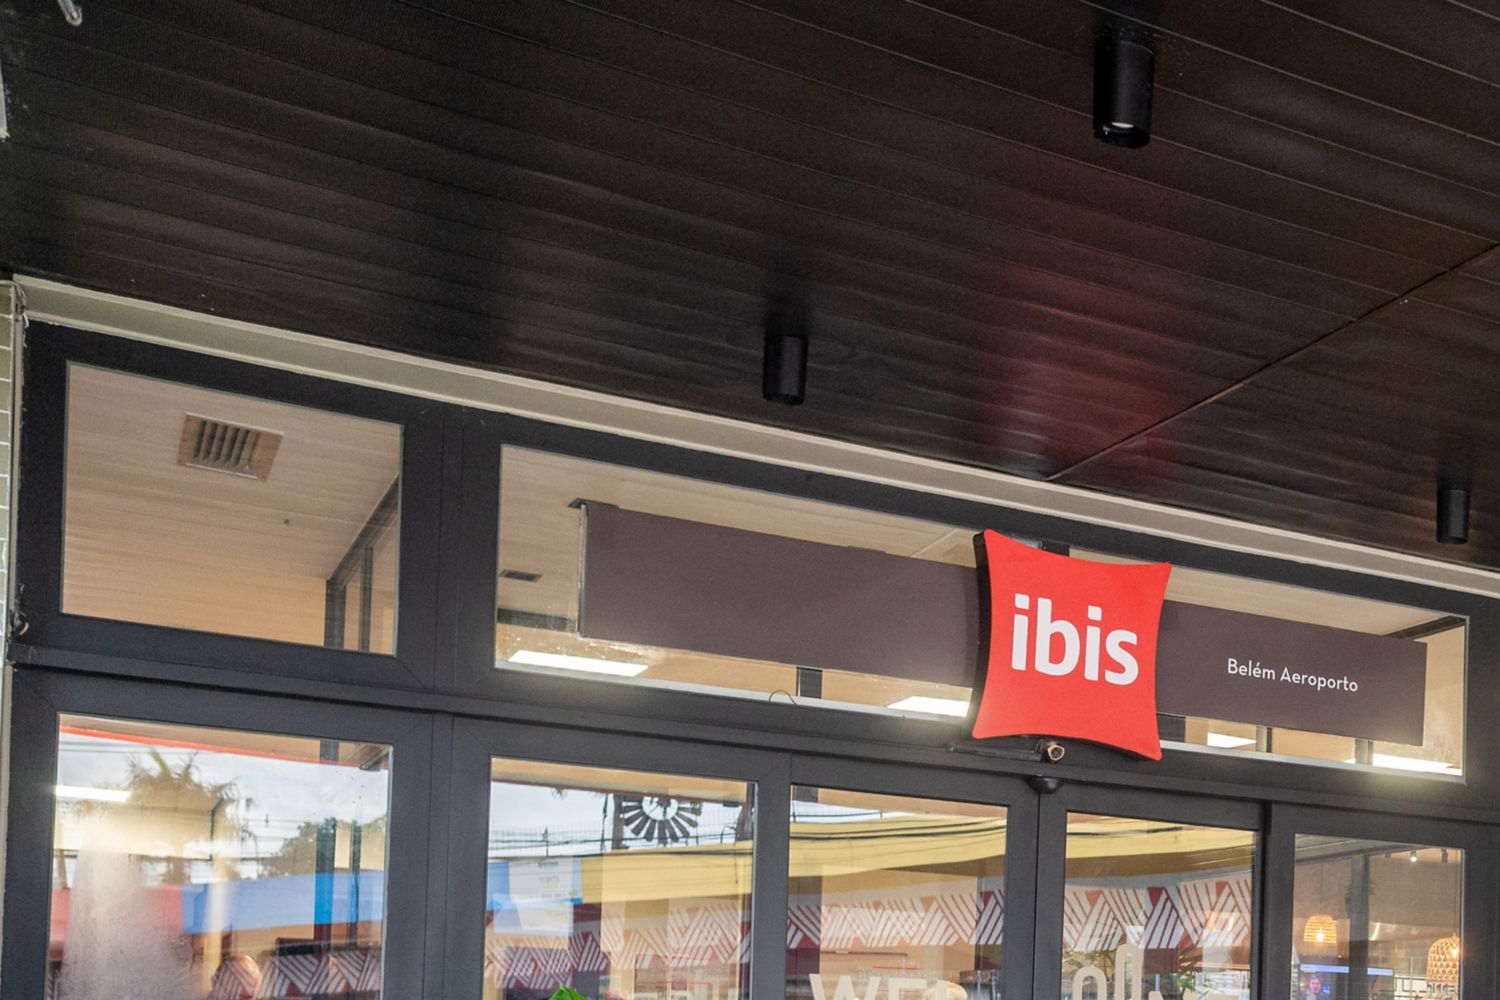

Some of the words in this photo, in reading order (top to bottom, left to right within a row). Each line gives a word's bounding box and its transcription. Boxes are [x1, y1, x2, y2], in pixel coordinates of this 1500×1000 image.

[1011, 593, 1139, 686] ibis
[1227, 657, 1276, 680] Belém
[1280, 666, 1359, 692] Aeroporto
